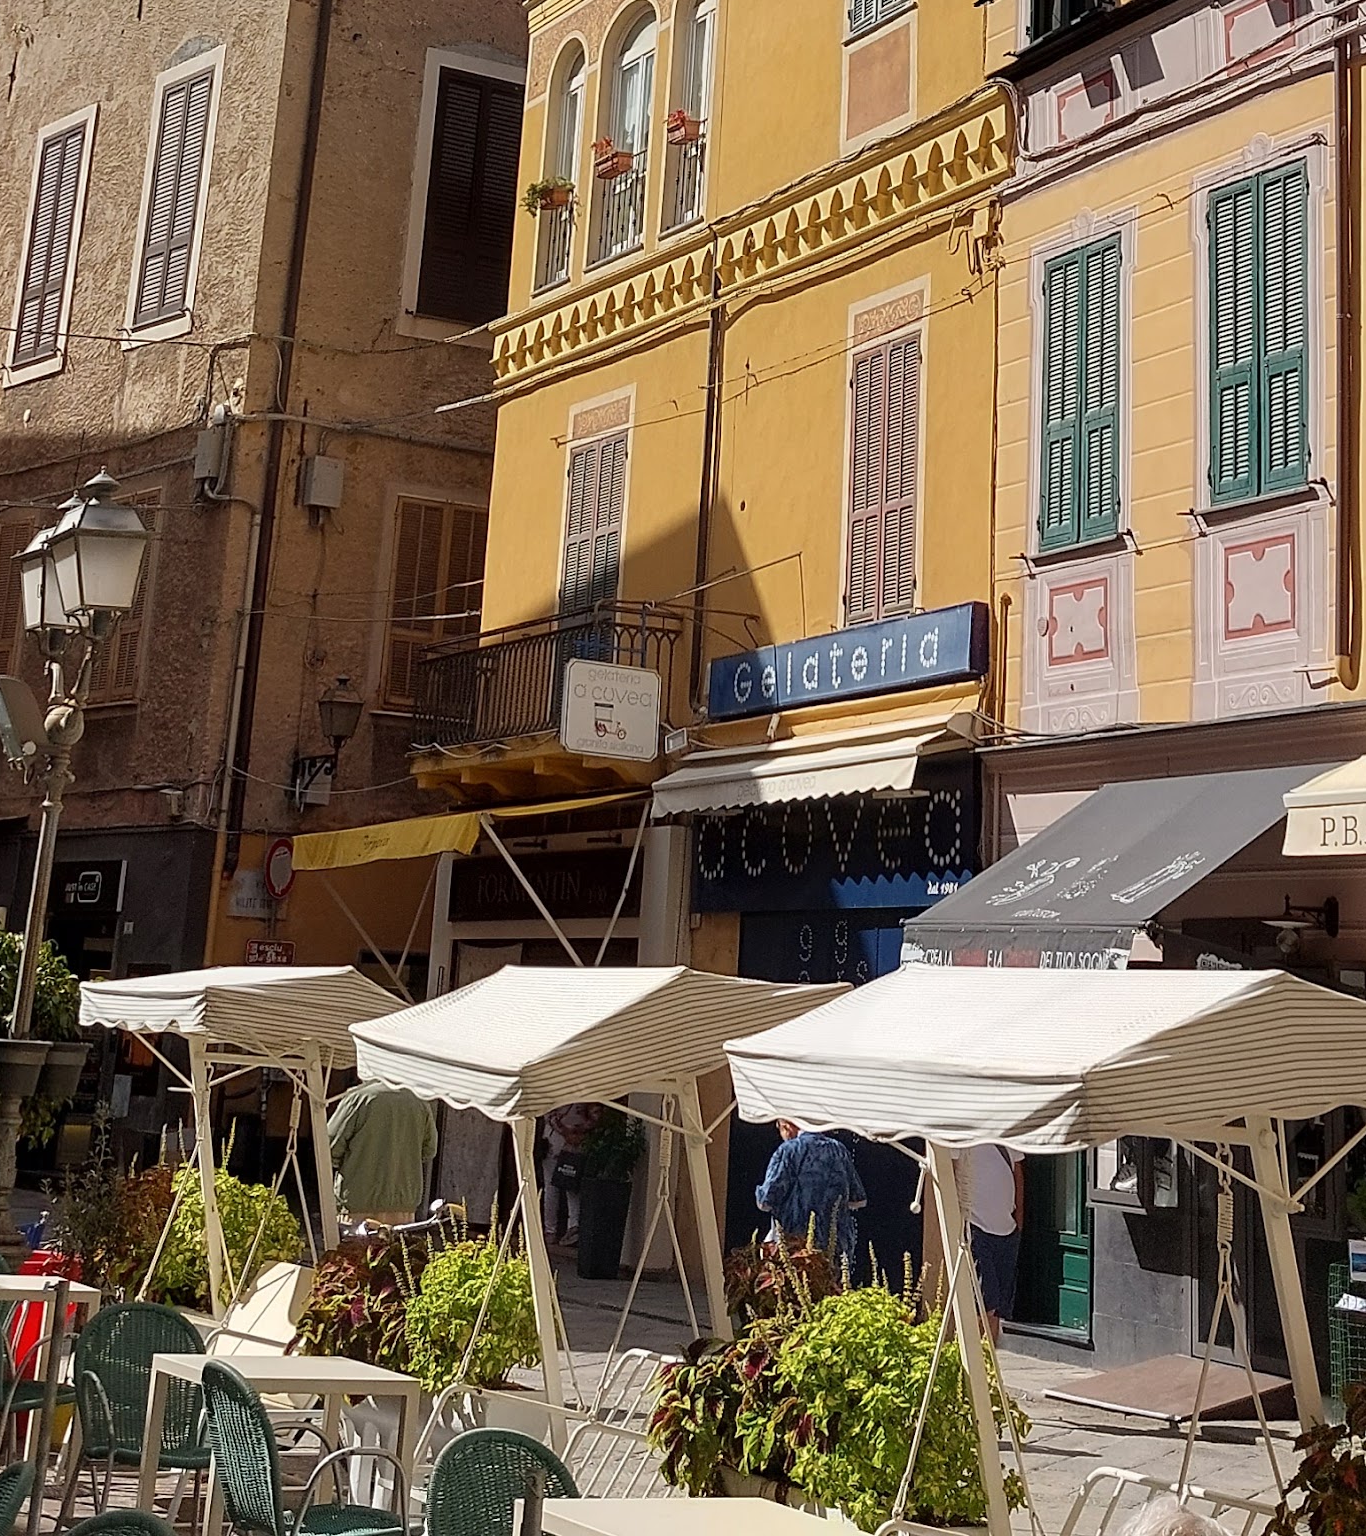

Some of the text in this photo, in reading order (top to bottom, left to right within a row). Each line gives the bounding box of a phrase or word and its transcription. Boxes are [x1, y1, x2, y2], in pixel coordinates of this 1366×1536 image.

[733, 626, 940, 704] Gelateria
[588, 668, 641, 685] gelateria
[591, 685, 652, 707] cuvea
[940, 880, 959, 895] 1981
